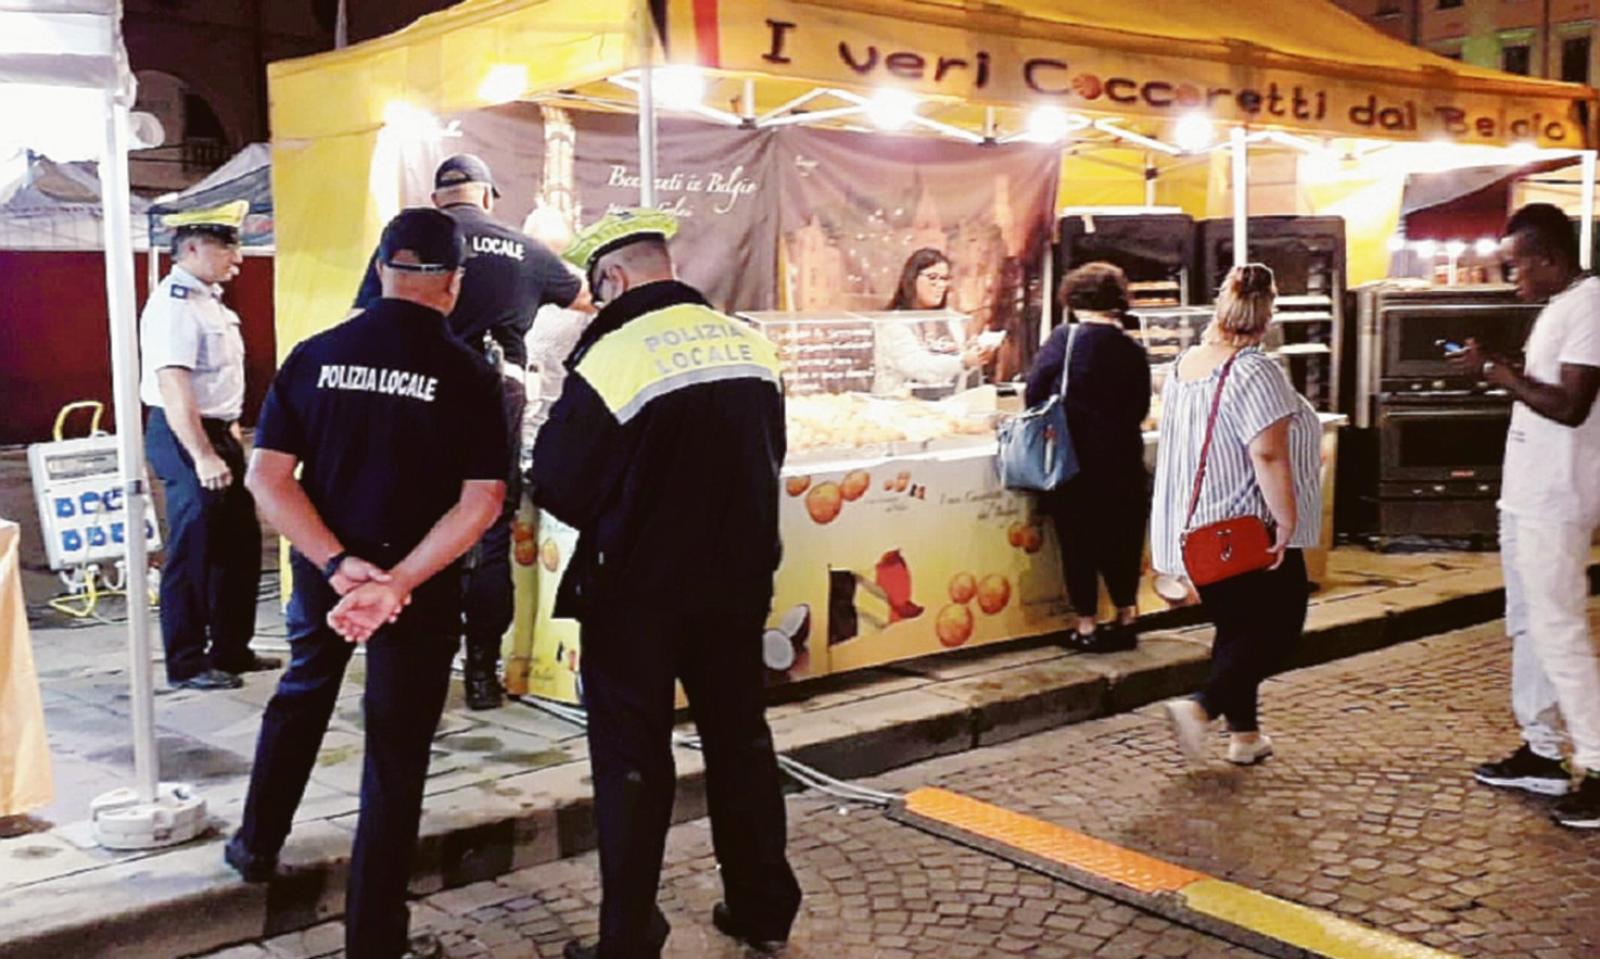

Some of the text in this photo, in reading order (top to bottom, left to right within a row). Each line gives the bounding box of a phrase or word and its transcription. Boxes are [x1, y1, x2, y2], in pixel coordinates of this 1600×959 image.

[761, 18, 796, 64] I
[838, 40, 990, 89] veri
[1348, 94, 1417, 132] dal
[472, 235, 527, 262] LOCALE
[643, 323, 744, 353] POLIZIA
[655, 343, 754, 374] LOCALE
[317, 364, 439, 402] POLIZIA LOCALE
